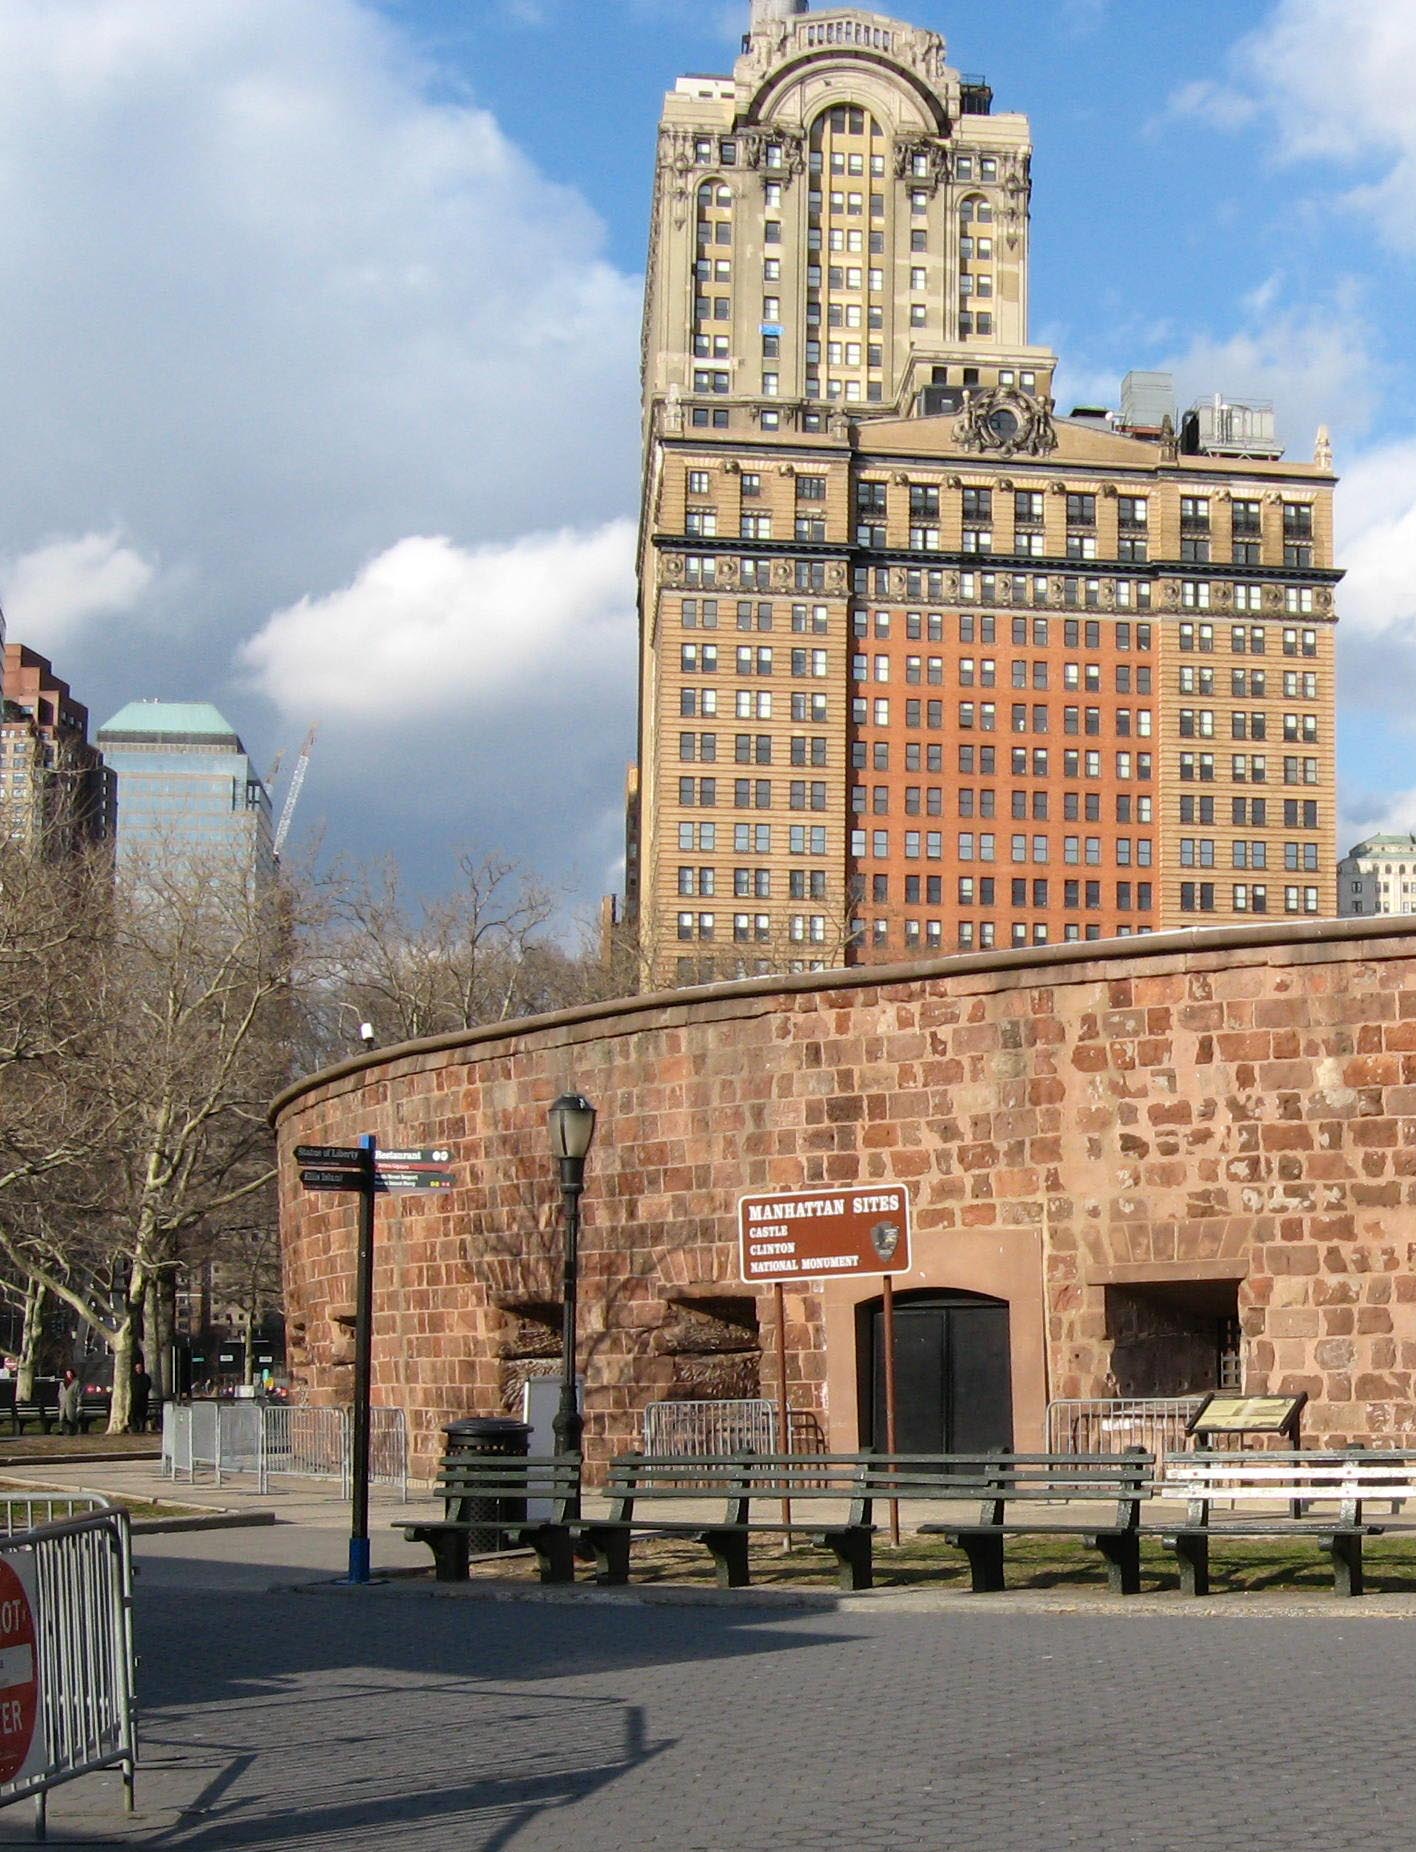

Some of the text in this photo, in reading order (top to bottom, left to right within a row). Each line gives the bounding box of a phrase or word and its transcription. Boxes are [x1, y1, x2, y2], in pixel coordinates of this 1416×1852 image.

[375, 1150, 422, 1160] Restaurant
[748, 1195, 900, 1221] MANHATTAN SITES
[749, 1225, 788, 1238] CASTLE
[750, 1242, 796, 1256] CLINTON
[750, 1255, 859, 1273] NATIONAL MONUMENT
[1, 1599, 21, 1633] OT
[0, 1701, 22, 1734] ER
